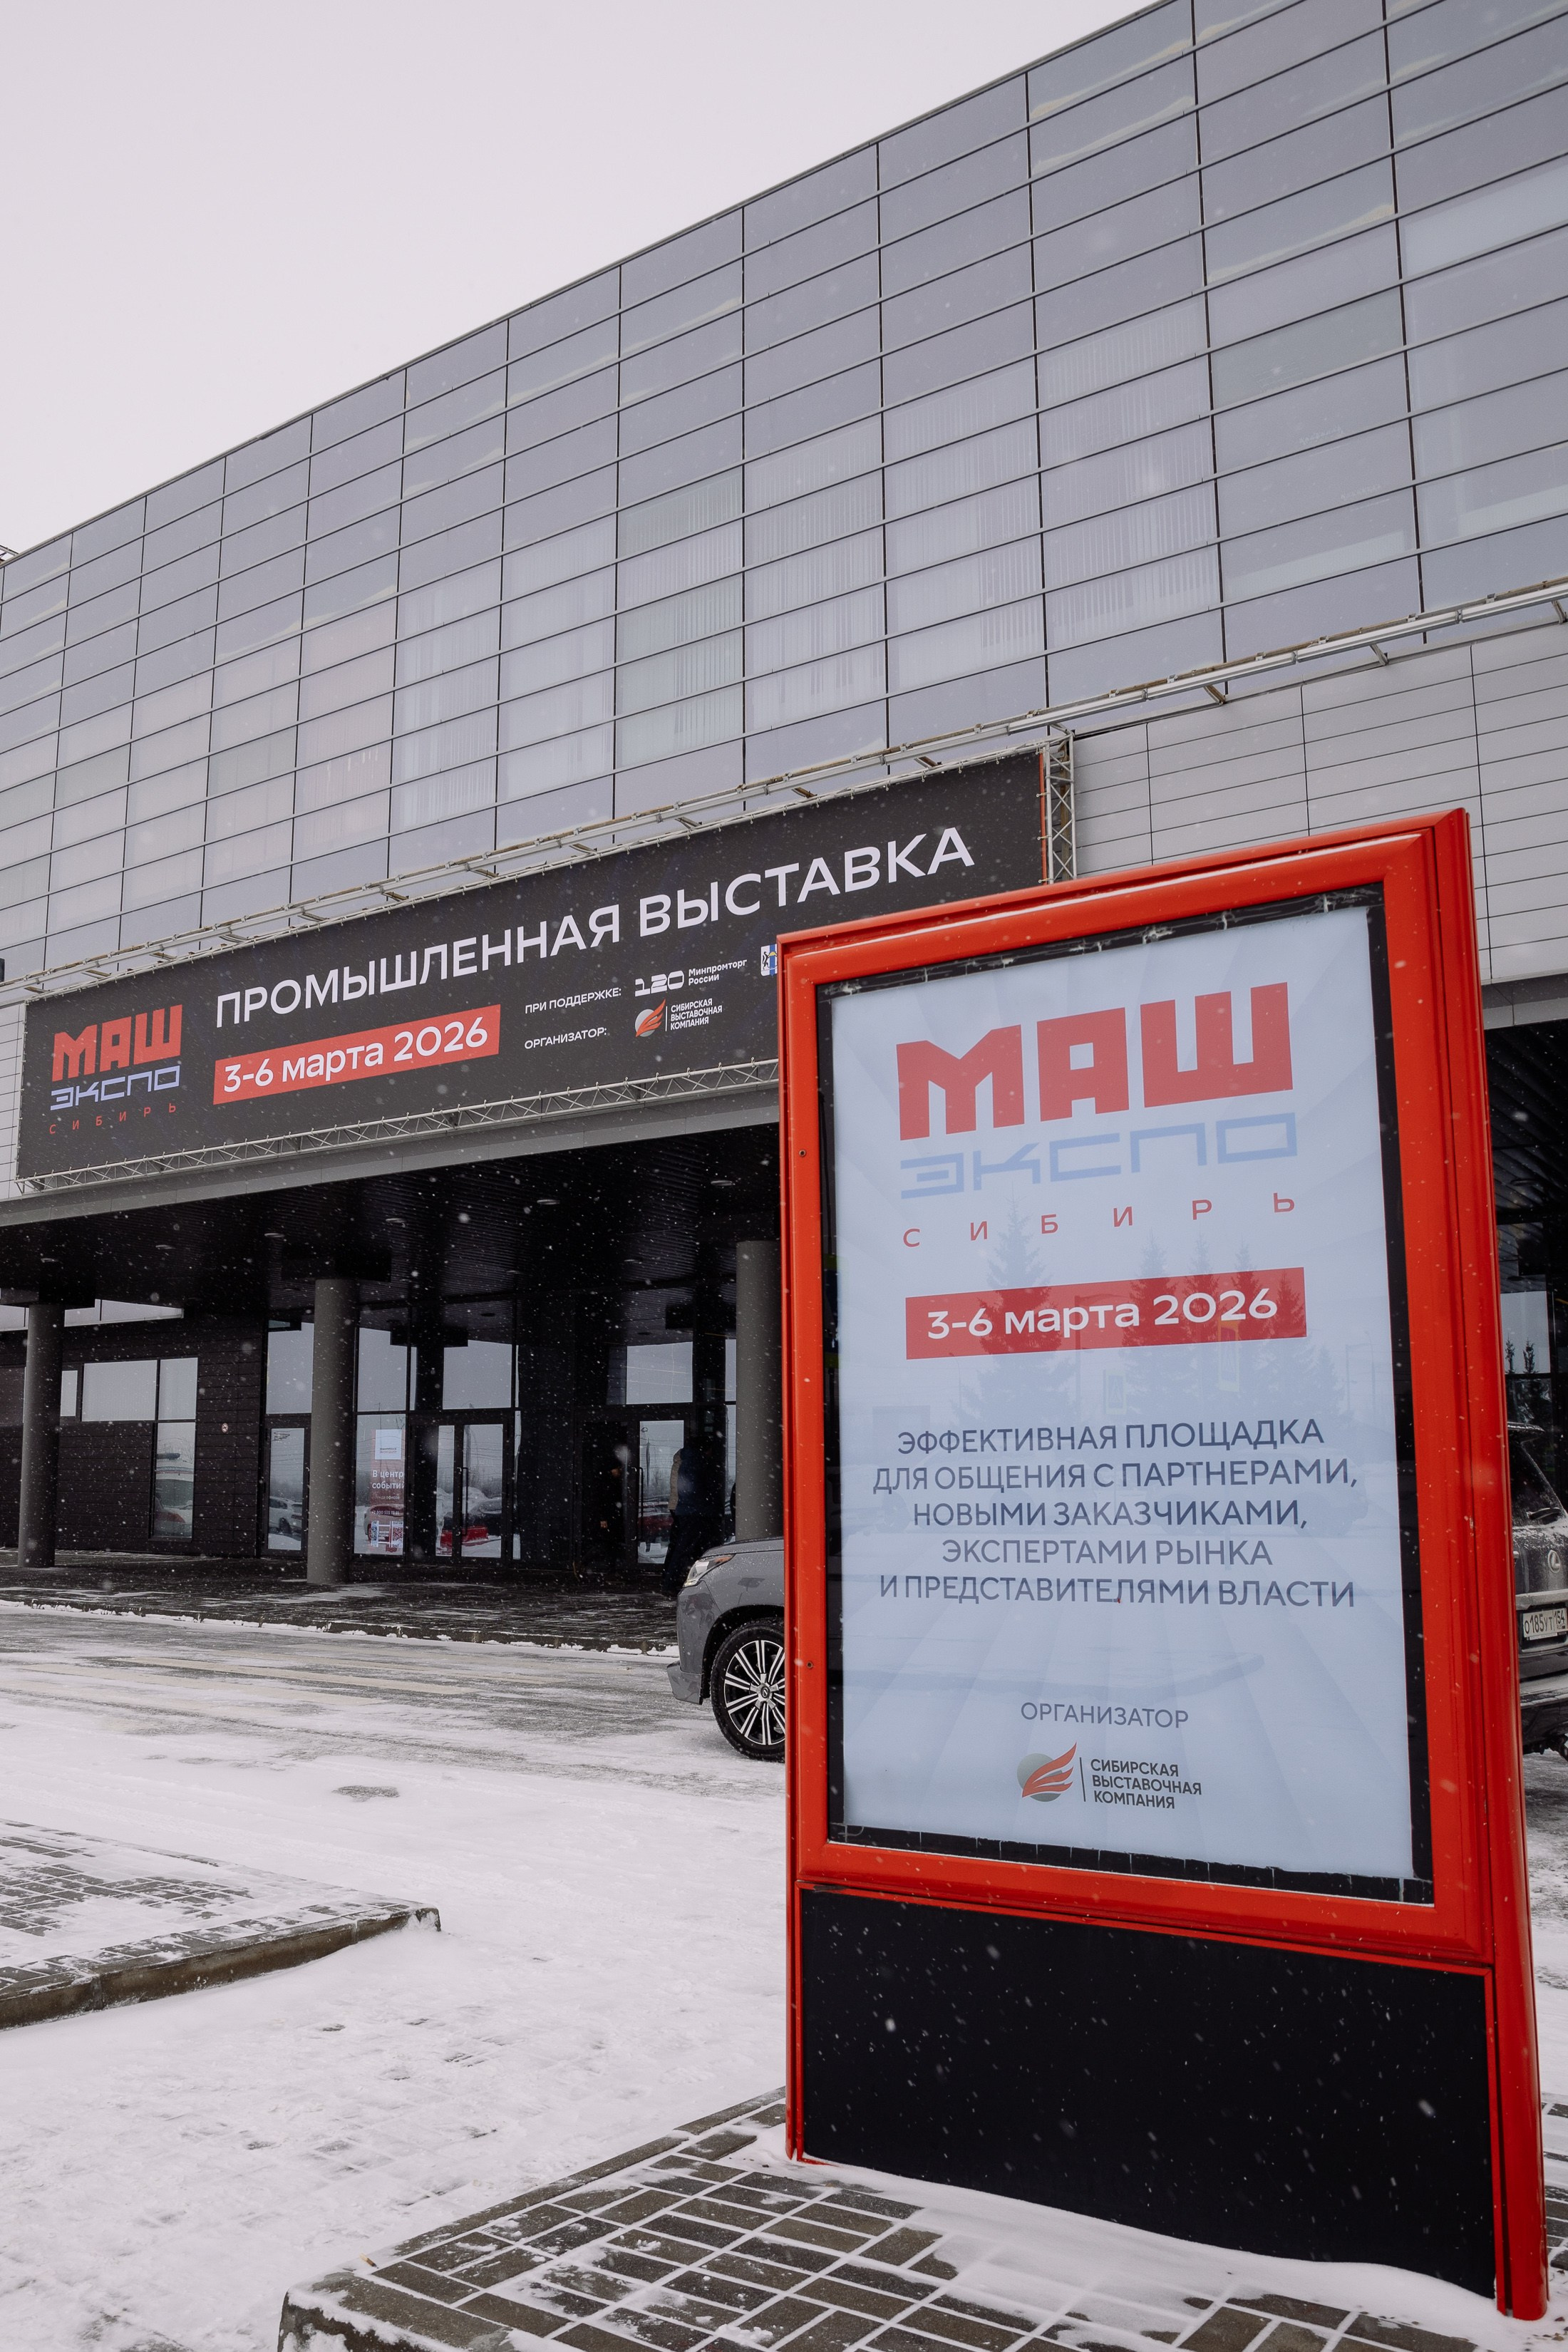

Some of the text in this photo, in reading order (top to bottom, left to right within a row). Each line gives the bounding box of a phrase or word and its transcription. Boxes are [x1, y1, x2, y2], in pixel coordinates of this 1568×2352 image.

[216, 827, 974, 1028] ПРОМЫШЛЕННАЯ ВЫСТАВКА
[688, 959, 747, 977] Минпромторг
[688, 974, 720, 986] России
[525, 987, 621, 1013] ПРИ ПОДДЕРЖКЕ:
[670, 1005, 723, 1021] ВЫСТАВОЧНАЯ
[671, 998, 713, 1013] СИБИРСКАЯ
[670, 1016, 709, 1031] КОМПАНИЯ
[52, 1004, 182, 1081] МАШ
[525, 1027, 607, 1049] ОРГАНИЗАТОР:
[224, 1016, 488, 1093] 3-6 марта 2026
[896, 981, 1294, 1140] МАШ
[50, 1065, 180, 1111] ЭКСПО
[49, 1103, 176, 1135] СИБИРЬ
[900, 1113, 1298, 1200] ЭКСПО
[903, 1192, 1295, 1247] СИБИРЬ
[928, 1288, 1278, 1339] 3-6 марта 2026
[898, 1419, 1324, 1454] ЭФФЕКТИВНАЯ ПЛОЩАДКА
[874, 1458, 1357, 1494] ДЛЯ ОБЩЕНИЯ С ПАРТНЕРАМИ,
[914, 1500, 1307, 1529] НОВЫМИ ЗАКАЗЧИКАМИ,
[942, 1539, 1273, 1566] ЭКСПЕРТАМИ РЫНКА
[880, 1575, 1355, 1607] И ПРЕДСТАВИТЕЛЯМИ ВЛАСТИ
[1554, 1610, 1565, 1624] 154
[1021, 1702, 1189, 1728] ОРГАНИЗАТОР
[1090, 1759, 1179, 1777] СИБИРСКАЯ
[1092, 1775, 1202, 1795] ВЫСТАВОЧНАЯ
[1094, 1790, 1175, 1809] КОМПАНИЯ
